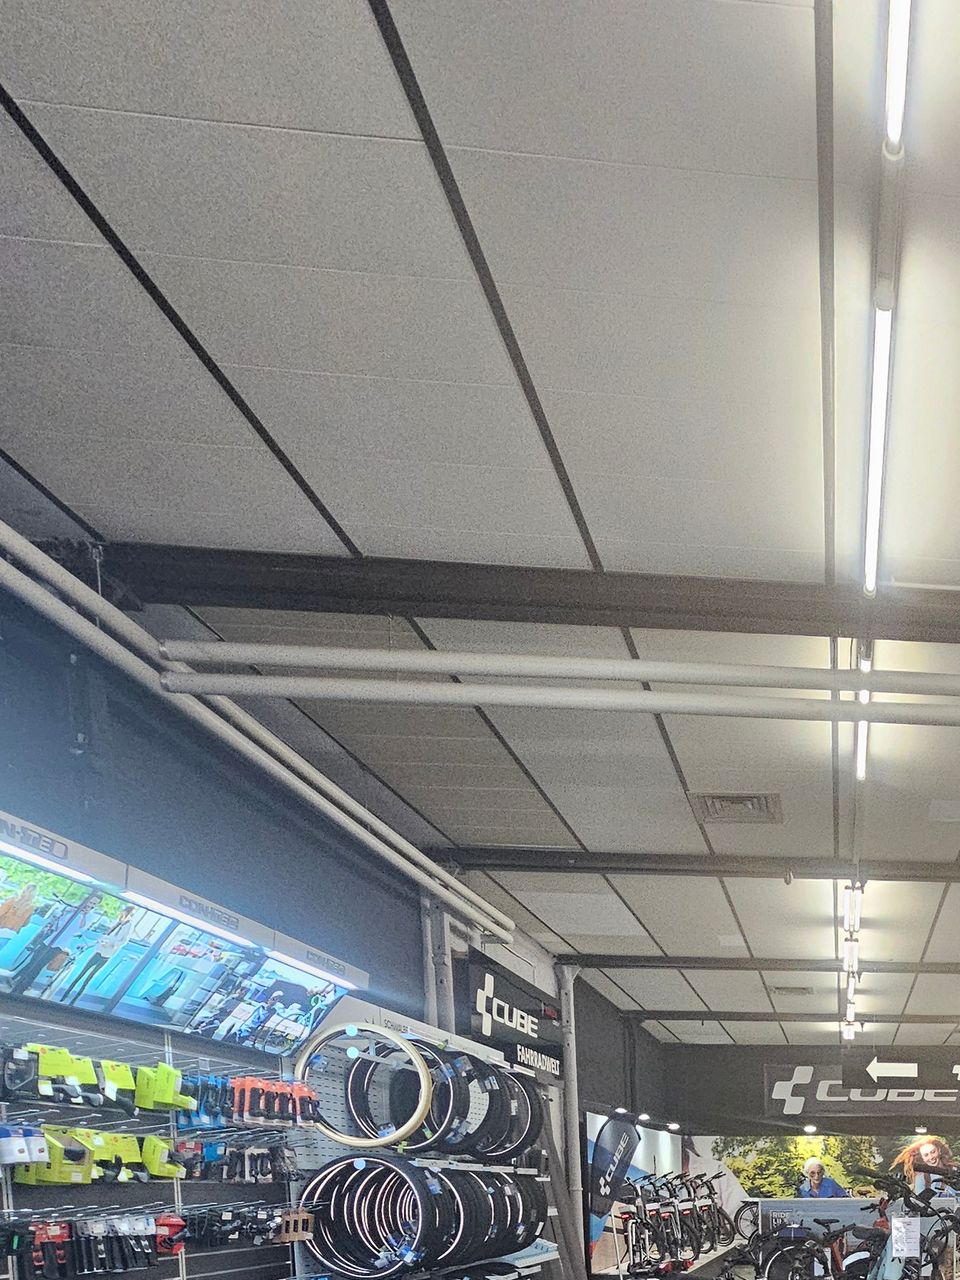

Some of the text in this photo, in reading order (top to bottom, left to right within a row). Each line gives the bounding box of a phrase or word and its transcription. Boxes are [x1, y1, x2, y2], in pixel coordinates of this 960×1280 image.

[492, 997, 539, 1038] CUBE
[516, 1043, 560, 1076] FAHRRADWELT
[605, 1132, 630, 1183] CUBE
